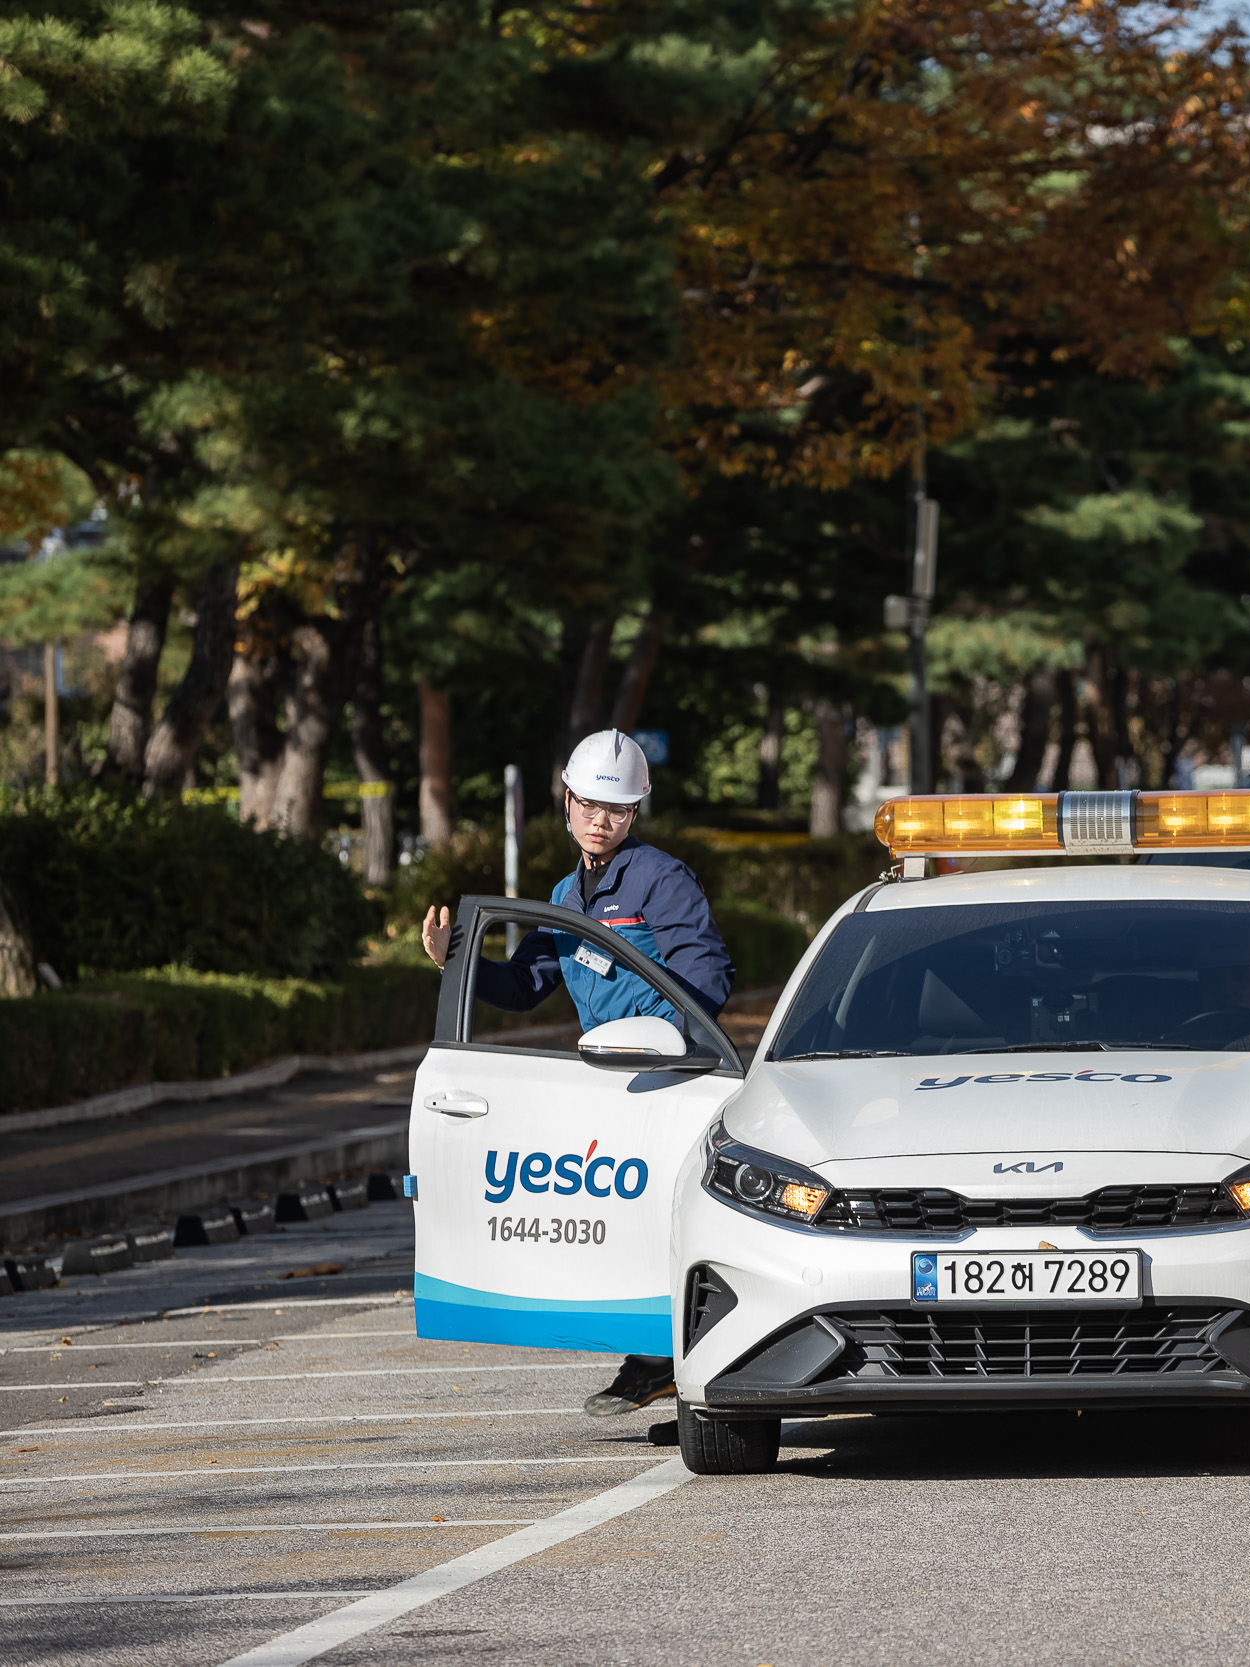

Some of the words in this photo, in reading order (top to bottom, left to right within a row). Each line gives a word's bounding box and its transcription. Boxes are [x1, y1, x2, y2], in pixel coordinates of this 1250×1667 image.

[596, 774, 620, 783] yesco
[913, 1069, 1173, 1091] yesco
[484, 1138, 649, 1204] yesco
[993, 1161, 1064, 1174] KIA
[487, 1215, 606, 1245] 1644-3030
[1044, 1258, 1130, 1293] 7289
